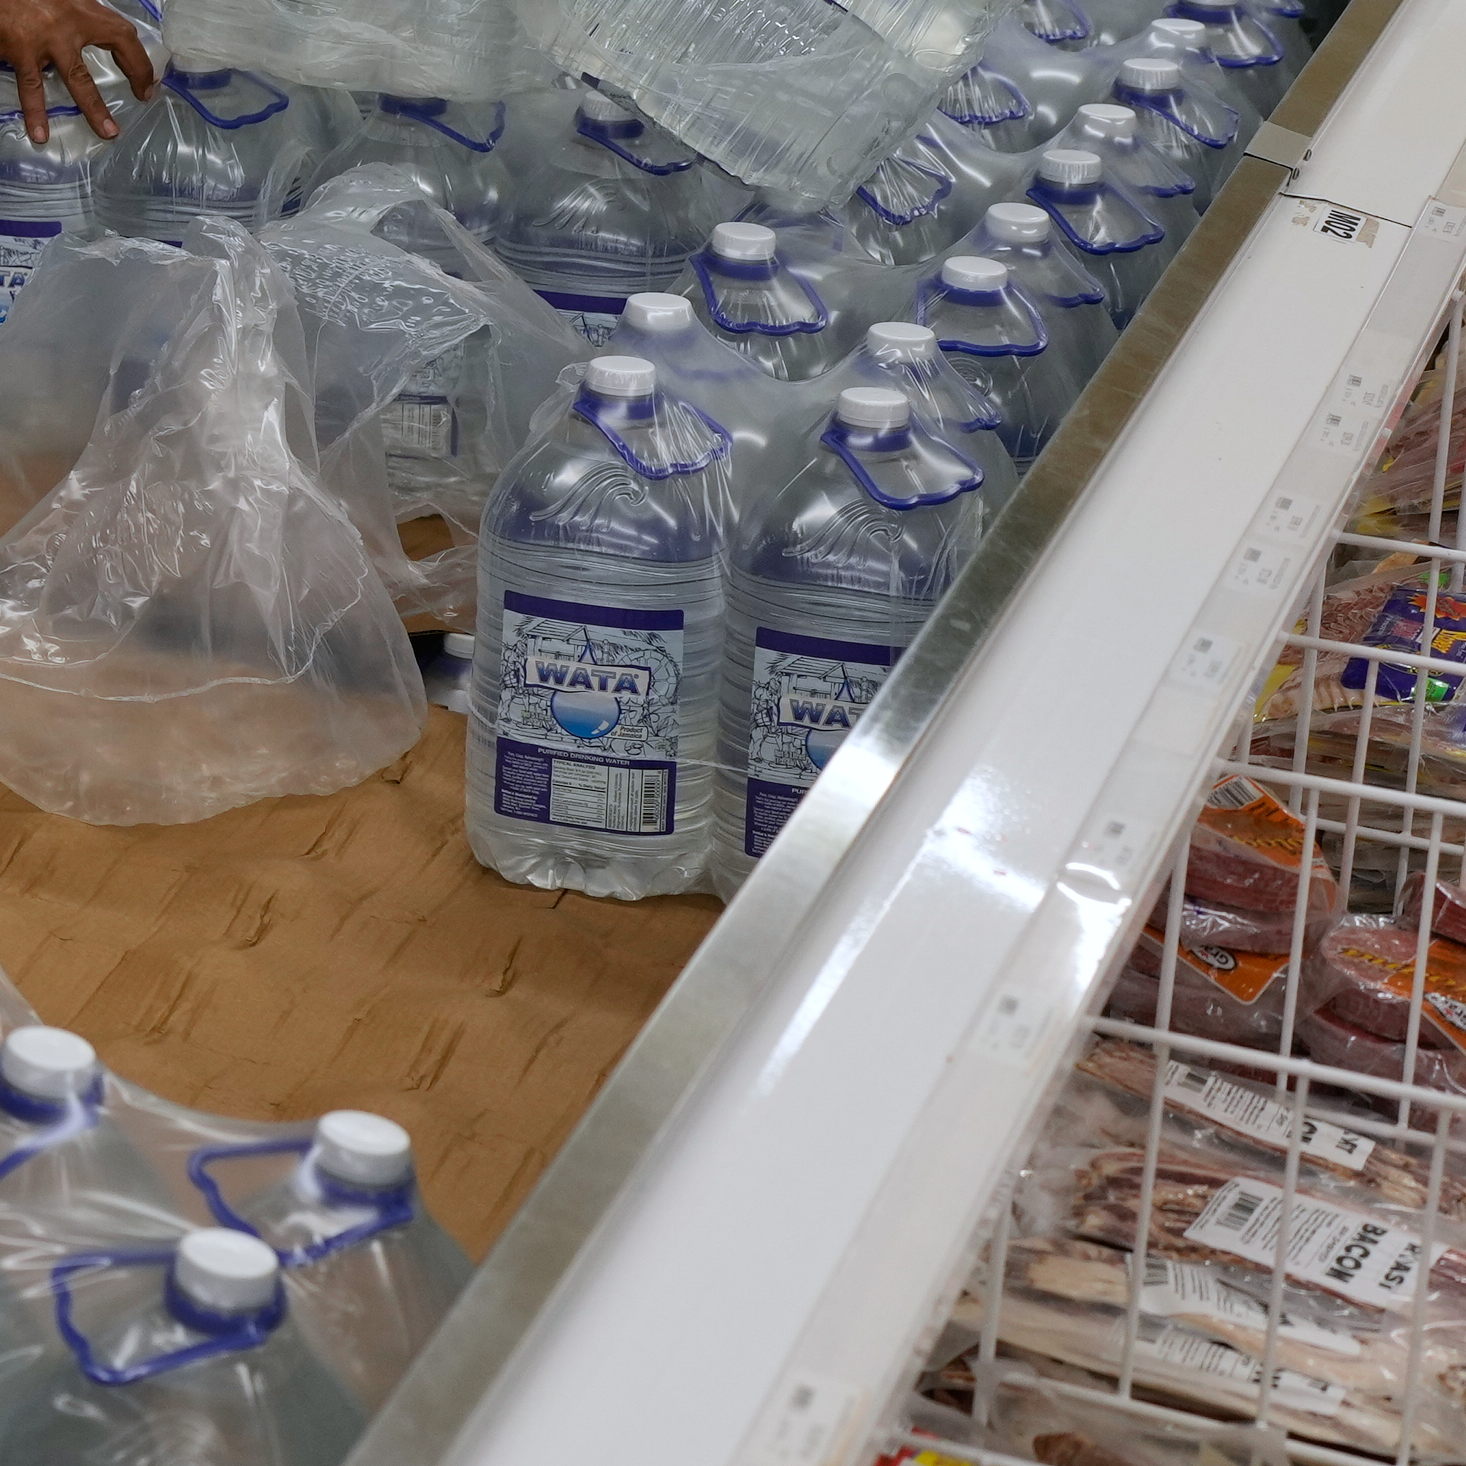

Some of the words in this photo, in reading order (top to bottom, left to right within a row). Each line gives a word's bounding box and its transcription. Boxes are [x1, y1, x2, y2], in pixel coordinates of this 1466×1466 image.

[1321, 209, 1363, 240] M02
[535, 661, 641, 696] WATA
[789, 698, 864, 729] WAT
[617, 731, 644, 739] Jamaica
[619, 726, 644, 734] Product
[537, 747, 569, 759] PURIFIED
[569, 752, 605, 764] DRINKING
[604, 758, 630, 766] WATER
[1325, 1222, 1388, 1284] BACON
